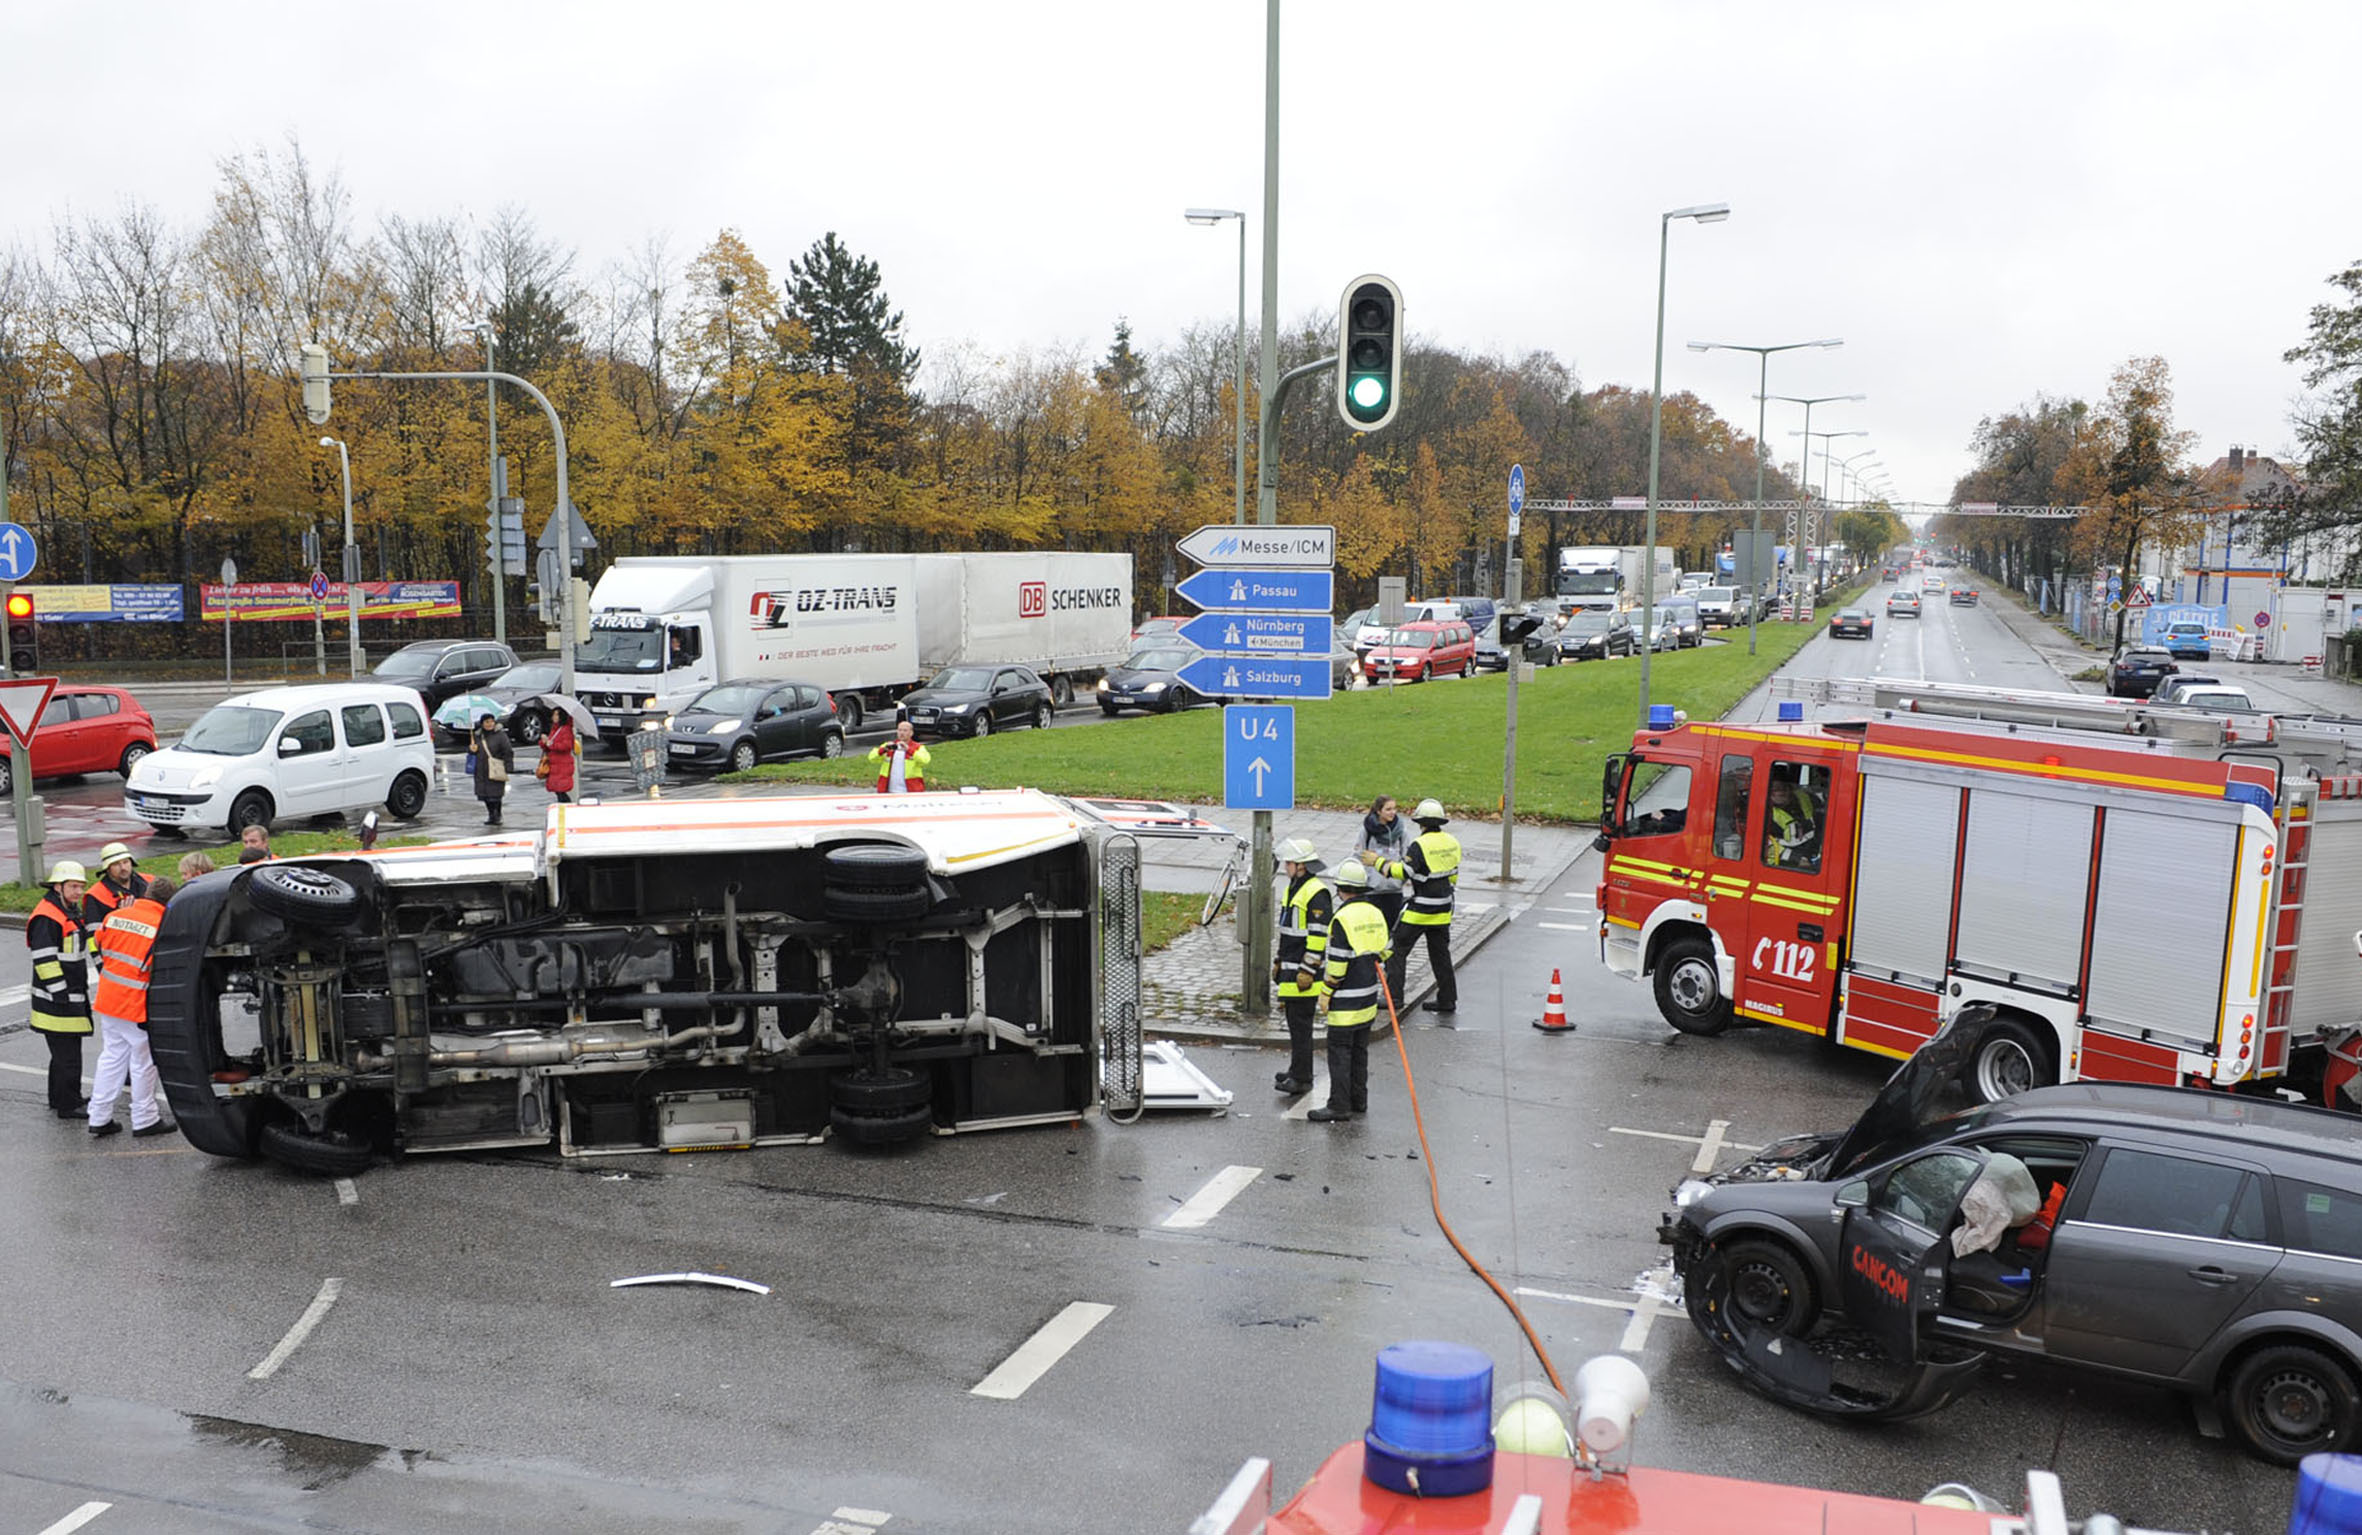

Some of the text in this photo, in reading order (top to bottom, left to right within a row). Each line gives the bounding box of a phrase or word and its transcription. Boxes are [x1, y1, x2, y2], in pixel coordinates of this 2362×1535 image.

[1241, 539, 1325, 554] Messe/ICM
[797, 586, 897, 612] OZ-TRANS
[1252, 584, 1298, 597] Passau
[1023, 588, 1122, 612] DB SCHENKER
[1246, 619, 1305, 634] Nürnberg
[1259, 637, 1303, 648] München
[1246, 671, 1302, 687] Salzburg
[1240, 717, 1278, 741] U 4
[112, 918, 150, 935] NOTARZT
[1771, 939, 1816, 983] 112
[1852, 1244, 1909, 1304] CANCOM
